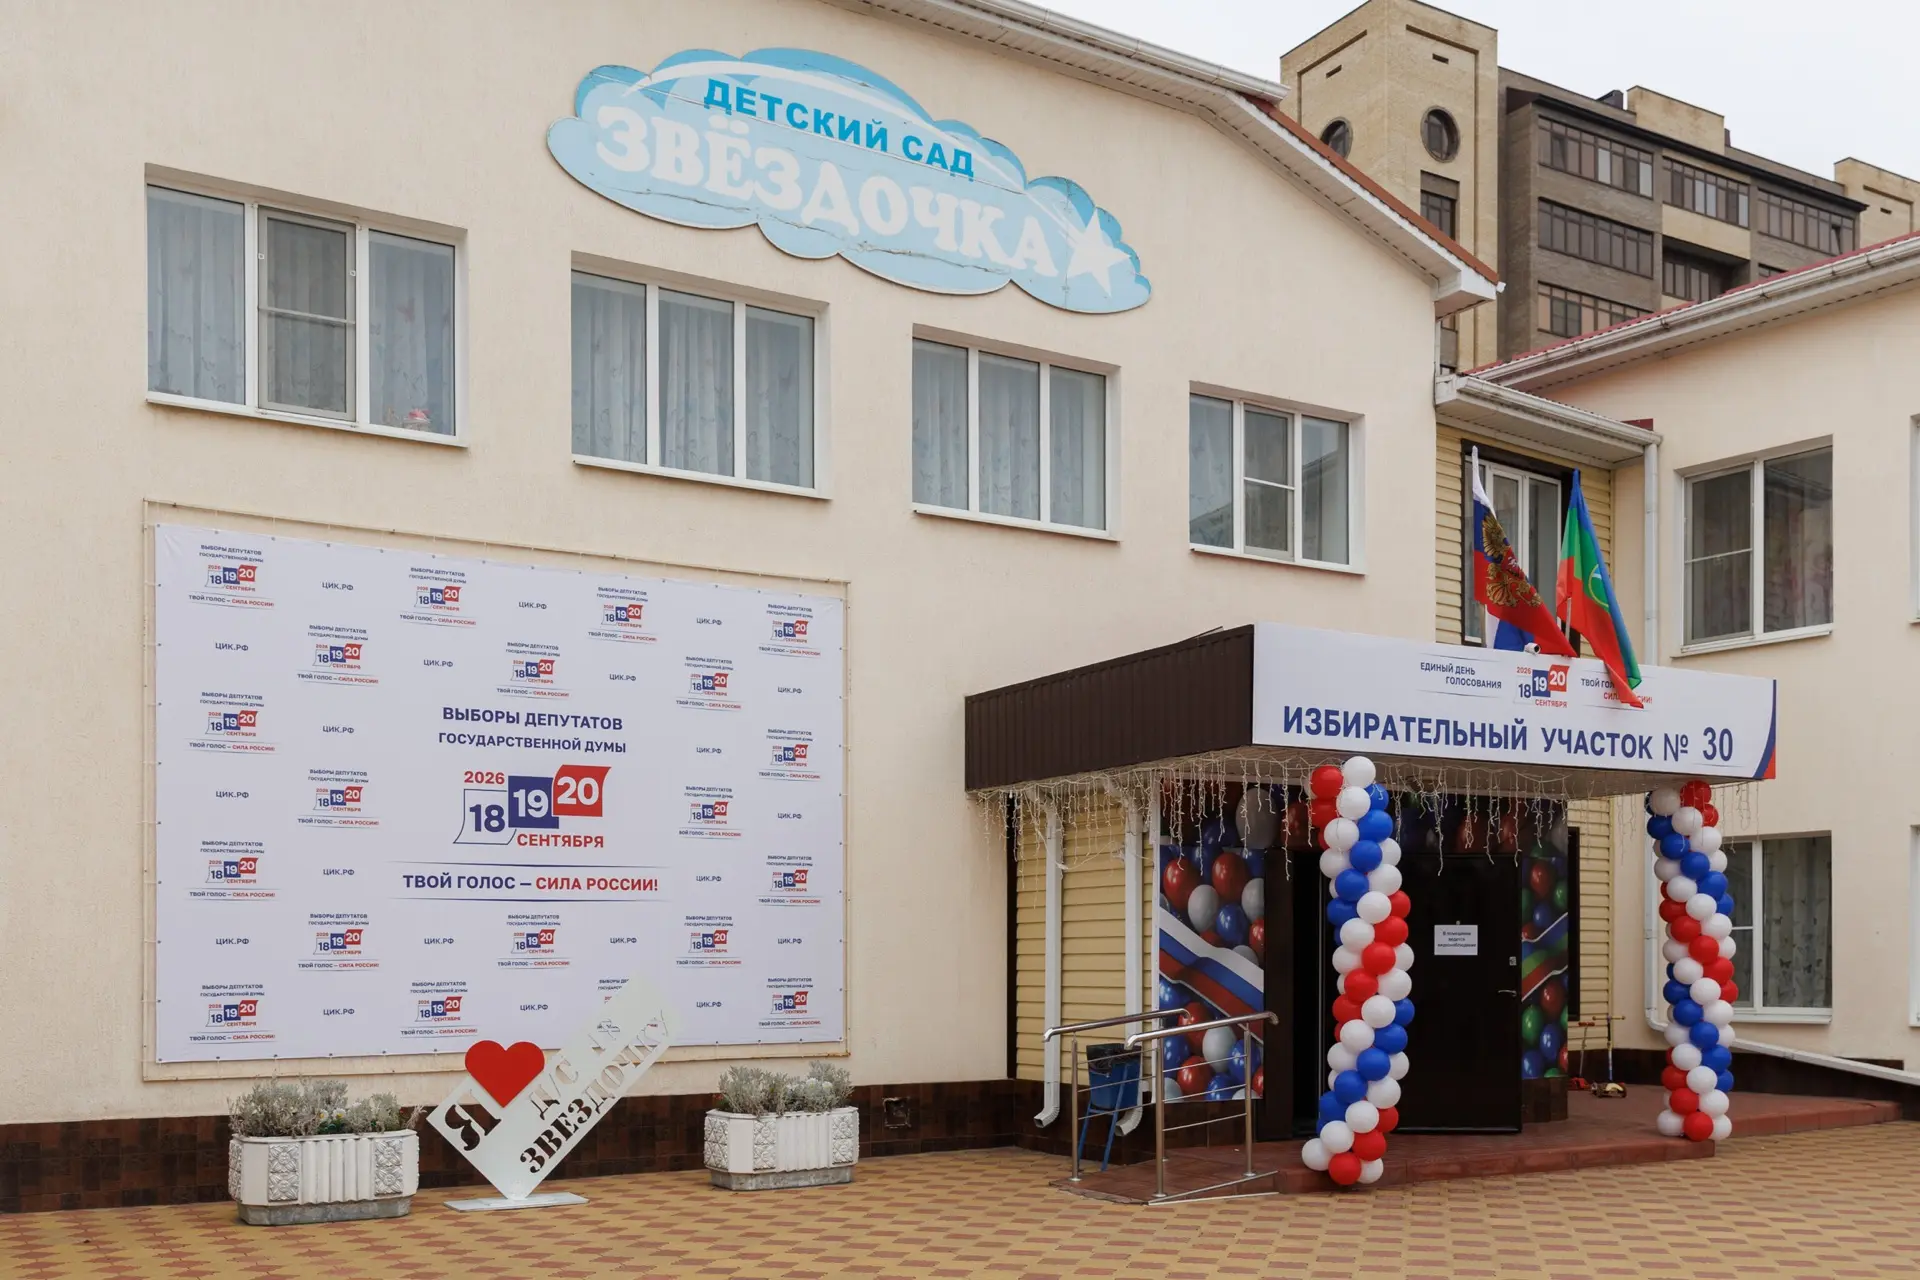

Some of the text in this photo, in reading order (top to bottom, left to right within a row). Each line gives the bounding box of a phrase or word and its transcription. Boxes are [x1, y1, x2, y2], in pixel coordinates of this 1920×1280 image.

[703, 78, 975, 182] ДЕТСКИЙ САД
[595, 104, 1059, 278] ЗВЁЗДОЧКА
[209, 568, 253, 584] 18 19 20
[322, 581, 353, 591] ЦИК.РФ
[418, 589, 457, 604] 18 19 20
[518, 601, 546, 610] ЦИК.РФ
[605, 607, 640, 622] 18 19 20
[696, 617, 722, 626] ЦИК.РФ
[774, 623, 805, 637] 18 19 20
[215, 642, 248, 651] ЦИК.РФ
[317, 647, 358, 663] 18 19 20
[423, 658, 453, 668] ЦИК.РФ
[514, 662, 551, 678] 18 19 20
[1420, 662, 1476, 676] ЕДИНЫЙ ДЕНЬ
[1516, 666, 1532, 674] 2026
[609, 673, 636, 682] ЦИК.РФ
[692, 676, 725, 690] 18 19 20
[1445, 676, 1502, 689] ГОЛОСОВАНИЯ
[1581, 678, 1614, 688] ТВОЙ ГОЛ
[778, 686, 802, 694] ЦИК.РФ
[1518, 671, 1566, 699] 18 19 20
[1604, 692, 1620, 700] СИЛ
[1535, 700, 1568, 708] СЕНТЯБРЯ
[210, 714, 254, 731] 18 19 20
[442, 707, 623, 730] ВЫБОРЫ ДЕПУТАТОВ
[322, 725, 354, 734] ЦИК.РФ
[1284, 705, 1734, 762] ИЗБИРАТЕЛЬНЫЙ УЧАСТОК № 30
[438, 732, 627, 753] ГОСУДАРСТВЕННОЙ ДУМЫ
[784, 750, 793, 758] 19
[464, 770, 505, 784] 2026
[216, 790, 249, 798] ЦИК.РФ
[318, 790, 359, 806] 18 19 20
[469, 776, 600, 833] 18 19 20
[703, 807, 712, 816] 19
[516, 833, 604, 848] СЕНТЯБРЯ
[210, 861, 254, 879] 18 19 20
[403, 872, 452, 889] ТВОЙ
[457, 876, 516, 890] ГОЛОС
[536, 877, 582, 890] СИЛА
[586, 877, 659, 891] РОССИИ!
[784, 875, 793, 884] 19
[318, 933, 359, 950] 18 19 20
[515, 941, 525, 949] 18
[527, 936, 538, 945] 19
[703, 936, 712, 945] 19
[420, 1000, 458, 1018] 18 19 20
[784, 998, 793, 1006] 19
[210, 1004, 254, 1023] 18 19 20
[444, 1088, 502, 1151] Я
